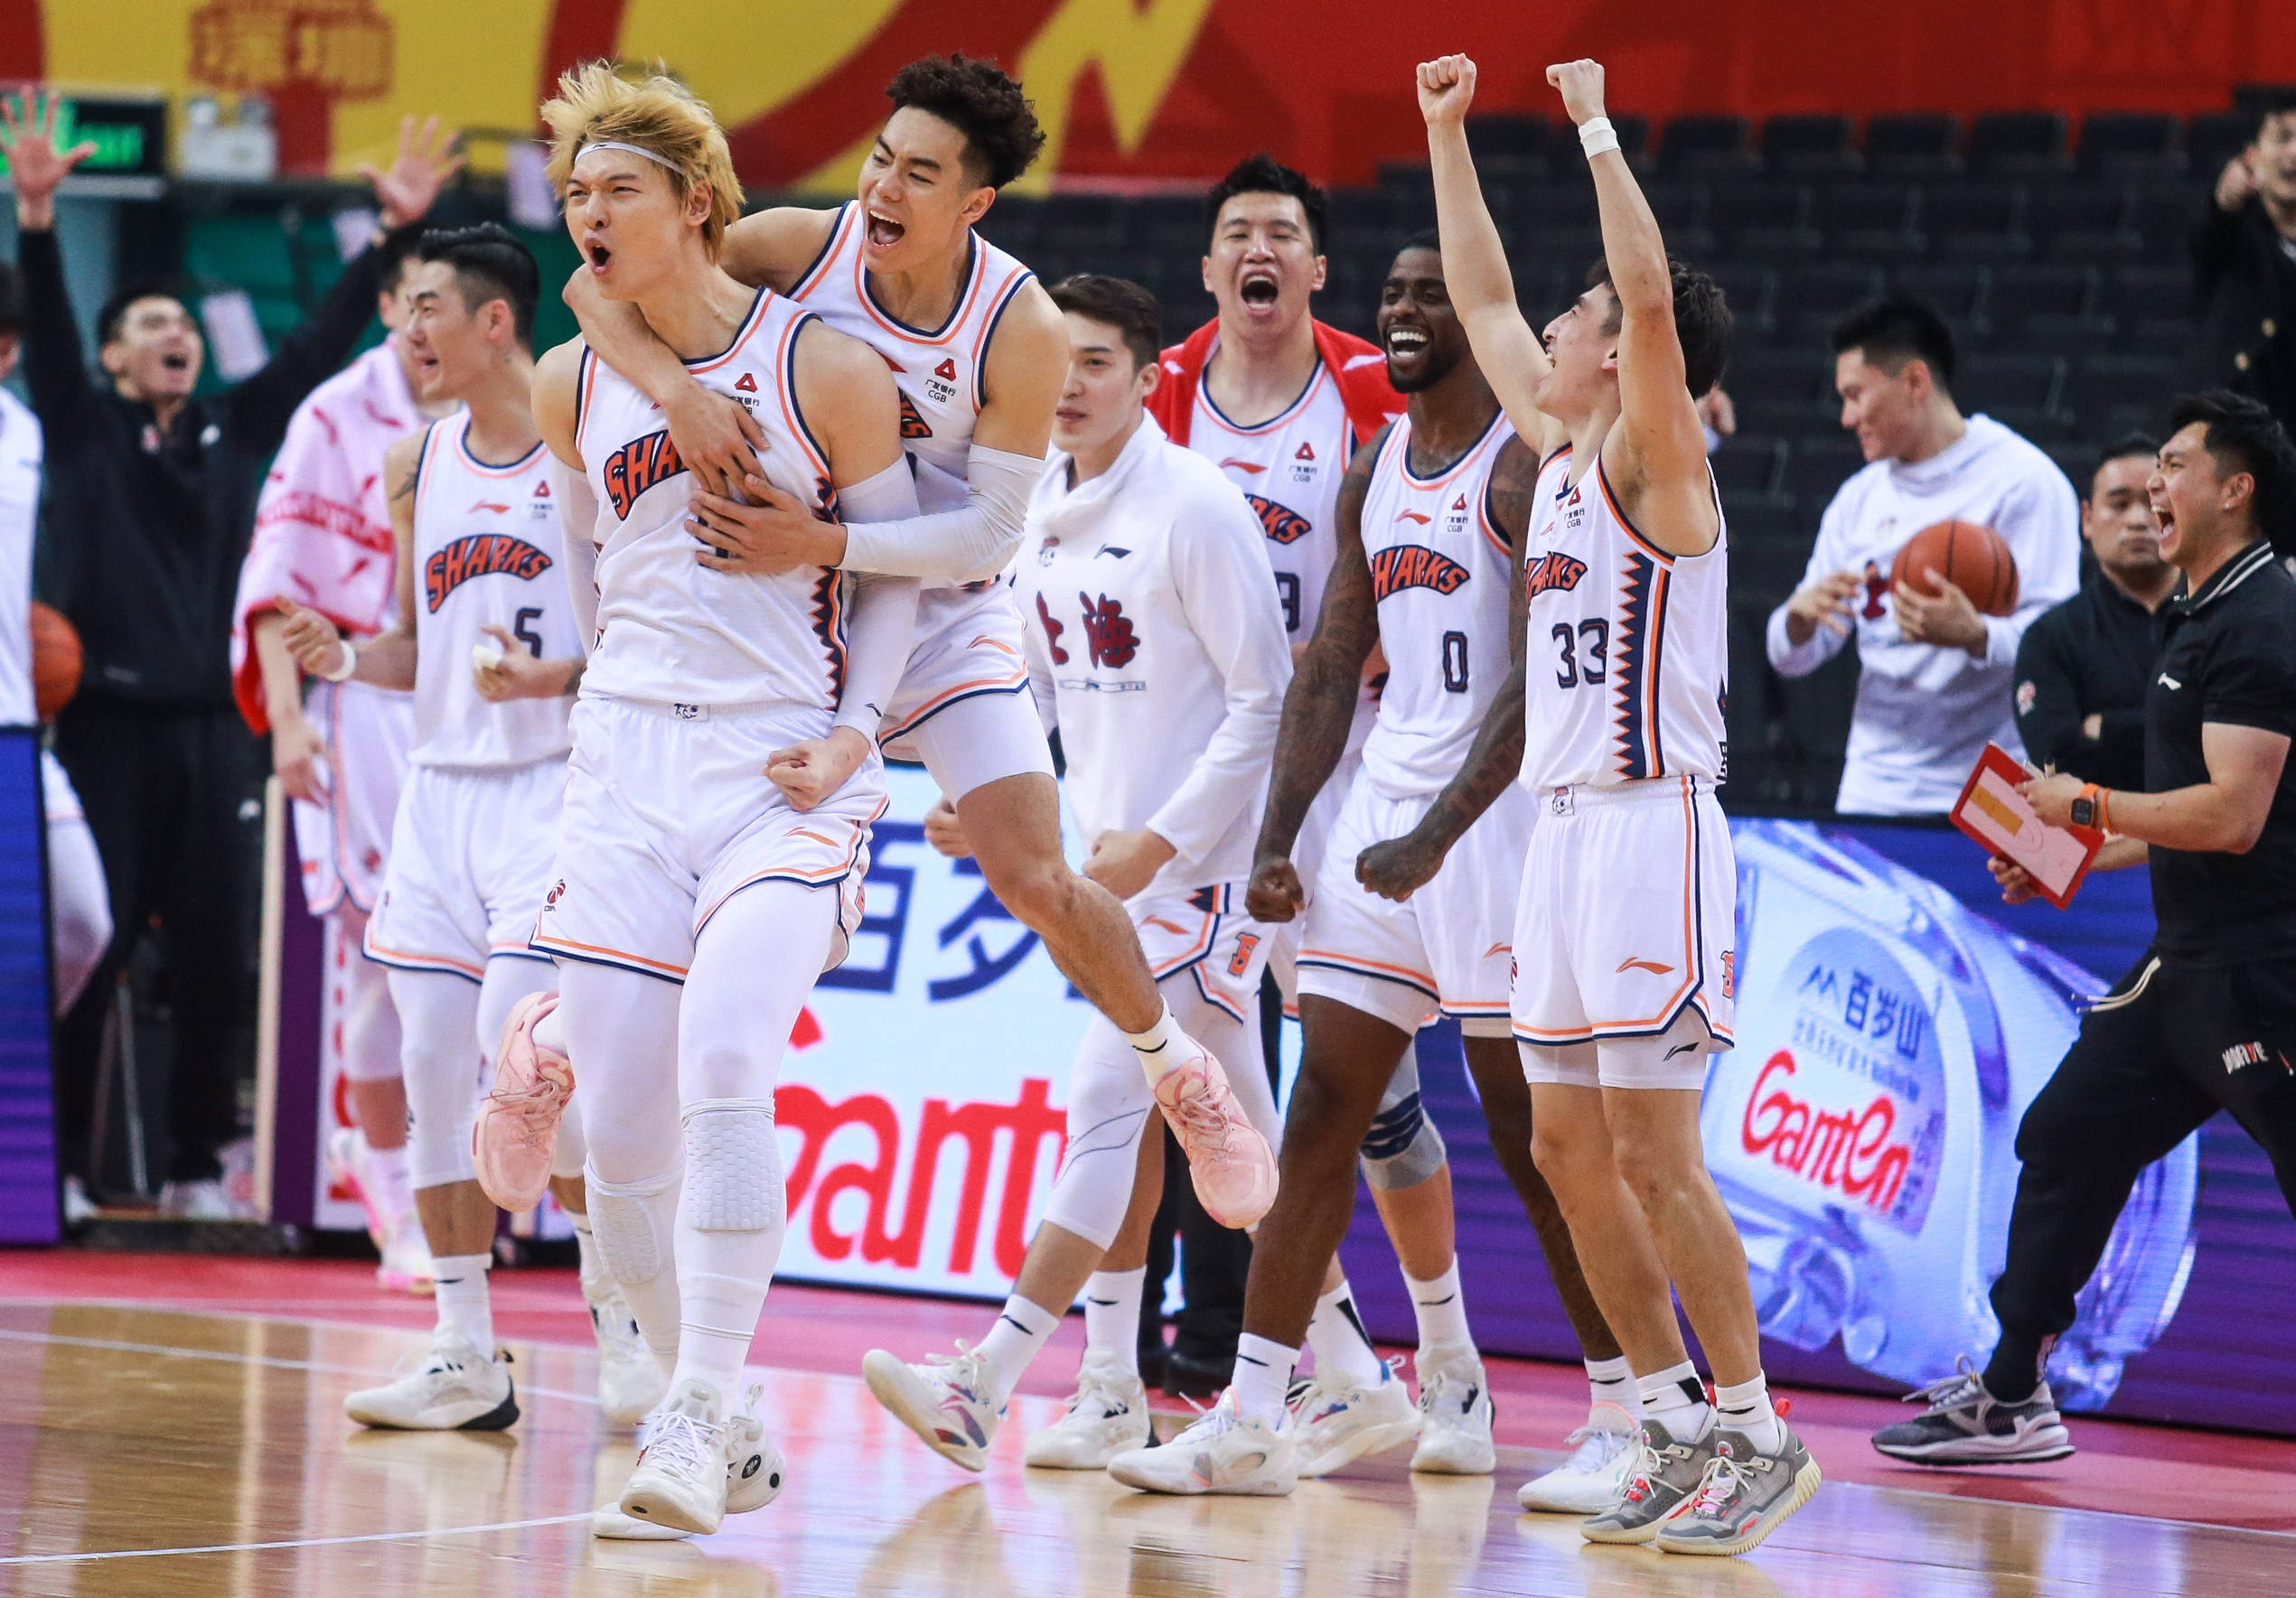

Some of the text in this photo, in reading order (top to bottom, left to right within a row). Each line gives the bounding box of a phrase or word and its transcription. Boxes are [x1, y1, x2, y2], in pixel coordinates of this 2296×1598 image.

[928, 389, 947, 403] CGB
[604, 428, 692, 521] SHA
[1447, 524, 1463, 533] CGB
[1567, 518, 1581, 528] CGB
[426, 533, 553, 614] SHARKS
[1372, 544, 1470, 603] HARKS
[514, 607, 545, 659] 5
[1036, 590, 1141, 670] 上海
[1551, 617, 1610, 689] 33
[1443, 631, 1469, 694] 0
[1845, 969, 1924, 1060] 百岁山
